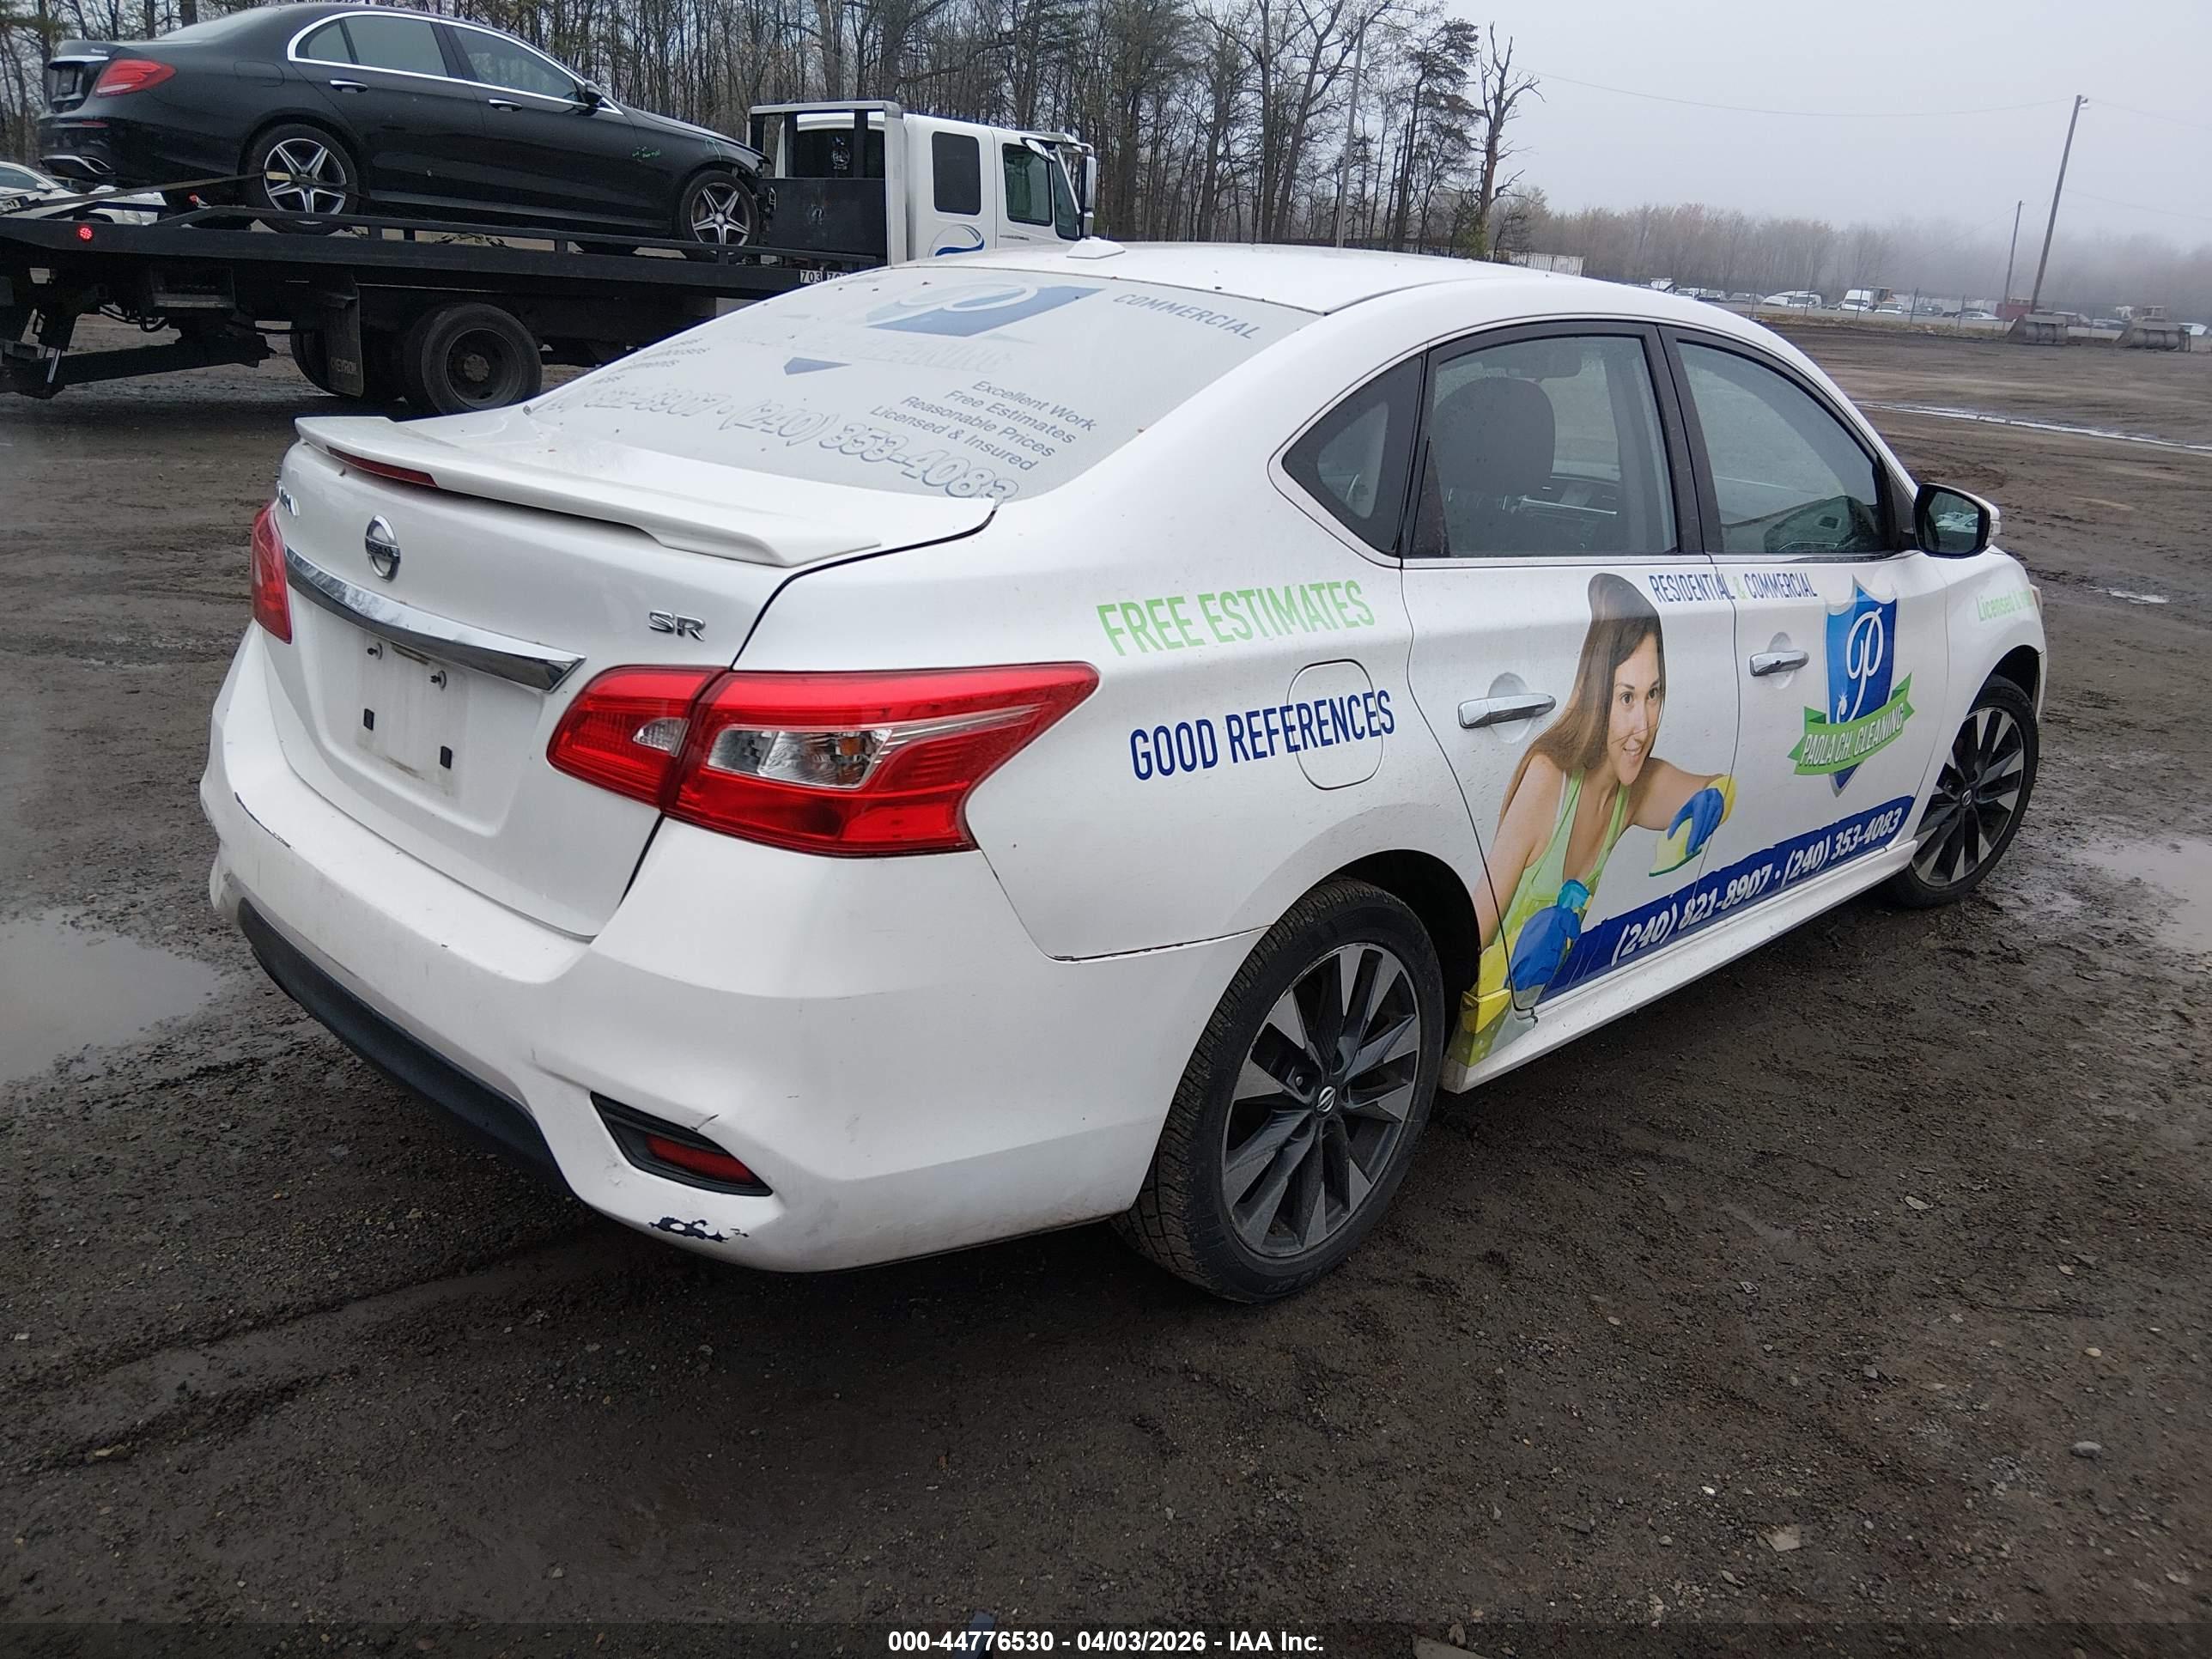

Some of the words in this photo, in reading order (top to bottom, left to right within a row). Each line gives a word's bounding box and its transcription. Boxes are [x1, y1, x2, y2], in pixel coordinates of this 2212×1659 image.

[800, 270, 822, 283] 703
[1112, 293, 1261, 339] COMMERCIAL
[900, 396, 998, 433] Reasonable
[998, 426, 1055, 458] Prices
[944, 390, 984, 409] Free
[986, 402, 1077, 444] Estimates
[972, 380, 1049, 411] Excellent
[1049, 404, 1097, 432] Work
[870, 405, 947, 435] Licensed
[947, 428, 965, 441] &
[963, 434, 1038, 471] Insured
[1649, 573, 1735, 602] RESIDENTIAL
[1733, 576, 1747, 600] &
[1744, 572, 1818, 599] COMMERCIAL
[648, 609, 706, 641] SR
[1097, 596, 1206, 657] FREE
[1197, 580, 1376, 642] ESTIMATES
[1129, 720, 1218, 781] GOOD
[1225, 690, 1395, 763] REFERENCES
[1800, 733, 1836, 766] PAOLA
[1853, 702, 1904, 757] CLEANING
[1610, 902, 1678, 967] (240)
[1678, 864, 1773, 931] 821-8907
[1780, 834, 1831, 889] (240)
[1830, 807, 1903, 861] 353-4083
